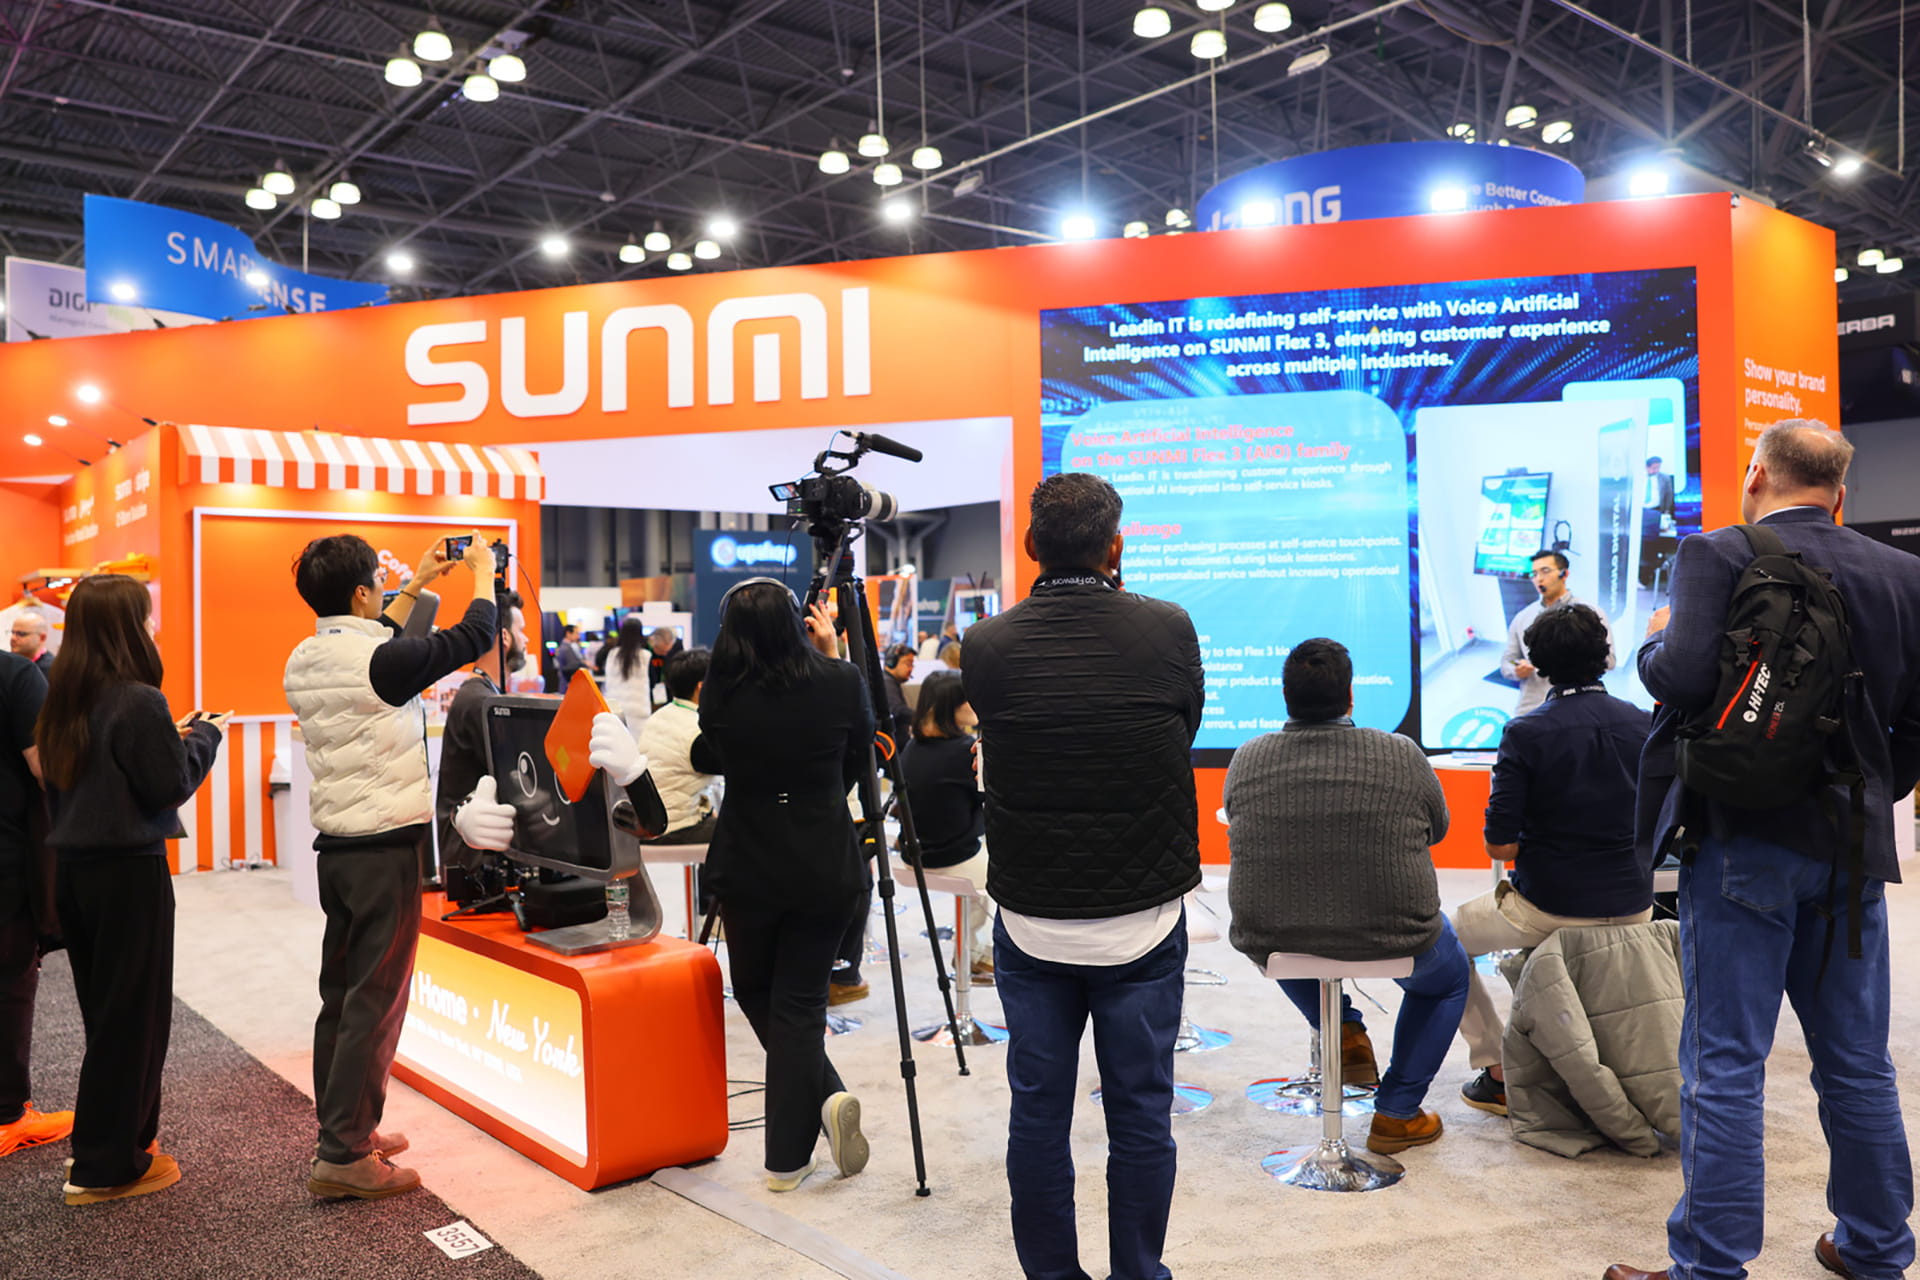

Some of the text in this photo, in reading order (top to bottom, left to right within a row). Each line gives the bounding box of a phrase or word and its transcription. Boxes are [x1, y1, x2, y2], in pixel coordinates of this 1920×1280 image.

[1485, 182, 1528, 201] Better
[1109, 292, 1579, 338] Leadin IT is redefining self-service with Voice Artificial
[1083, 317, 1611, 364] Intelligence on SUNMI Flex 3, elevating customer experience
[404, 286, 872, 426] SUNMI
[1226, 350, 1454, 378] across multiple industries.
[1744, 357, 1826, 393] Show your brand
[1744, 387, 1803, 416] personality.
[1071, 424, 1294, 447] Voice Artificial Intelligence
[1071, 441, 1351, 468] on the SUNMI Flex 3 (AIO) family
[1241, 465, 1288, 478] customer
[1292, 463, 1346, 477] experience
[1350, 460, 1392, 475] through
[1121, 521, 1182, 539] allenge
[1280, 537, 1337, 550] self-service
[1338, 536, 1402, 549] touchpoints.
[1213, 568, 1247, 580] service
[1248, 567, 1286, 578] without
[1288, 567, 1340, 579] increasing
[1225, 646, 1242, 657] the
[1244, 645, 1264, 657] Flex
[1230, 675, 1269, 688] product
[1204, 719, 1236, 730] errors,
[1238, 718, 1257, 730] and
[486, 999, 528, 1053] New
[437, 1226, 480, 1253] 3557
